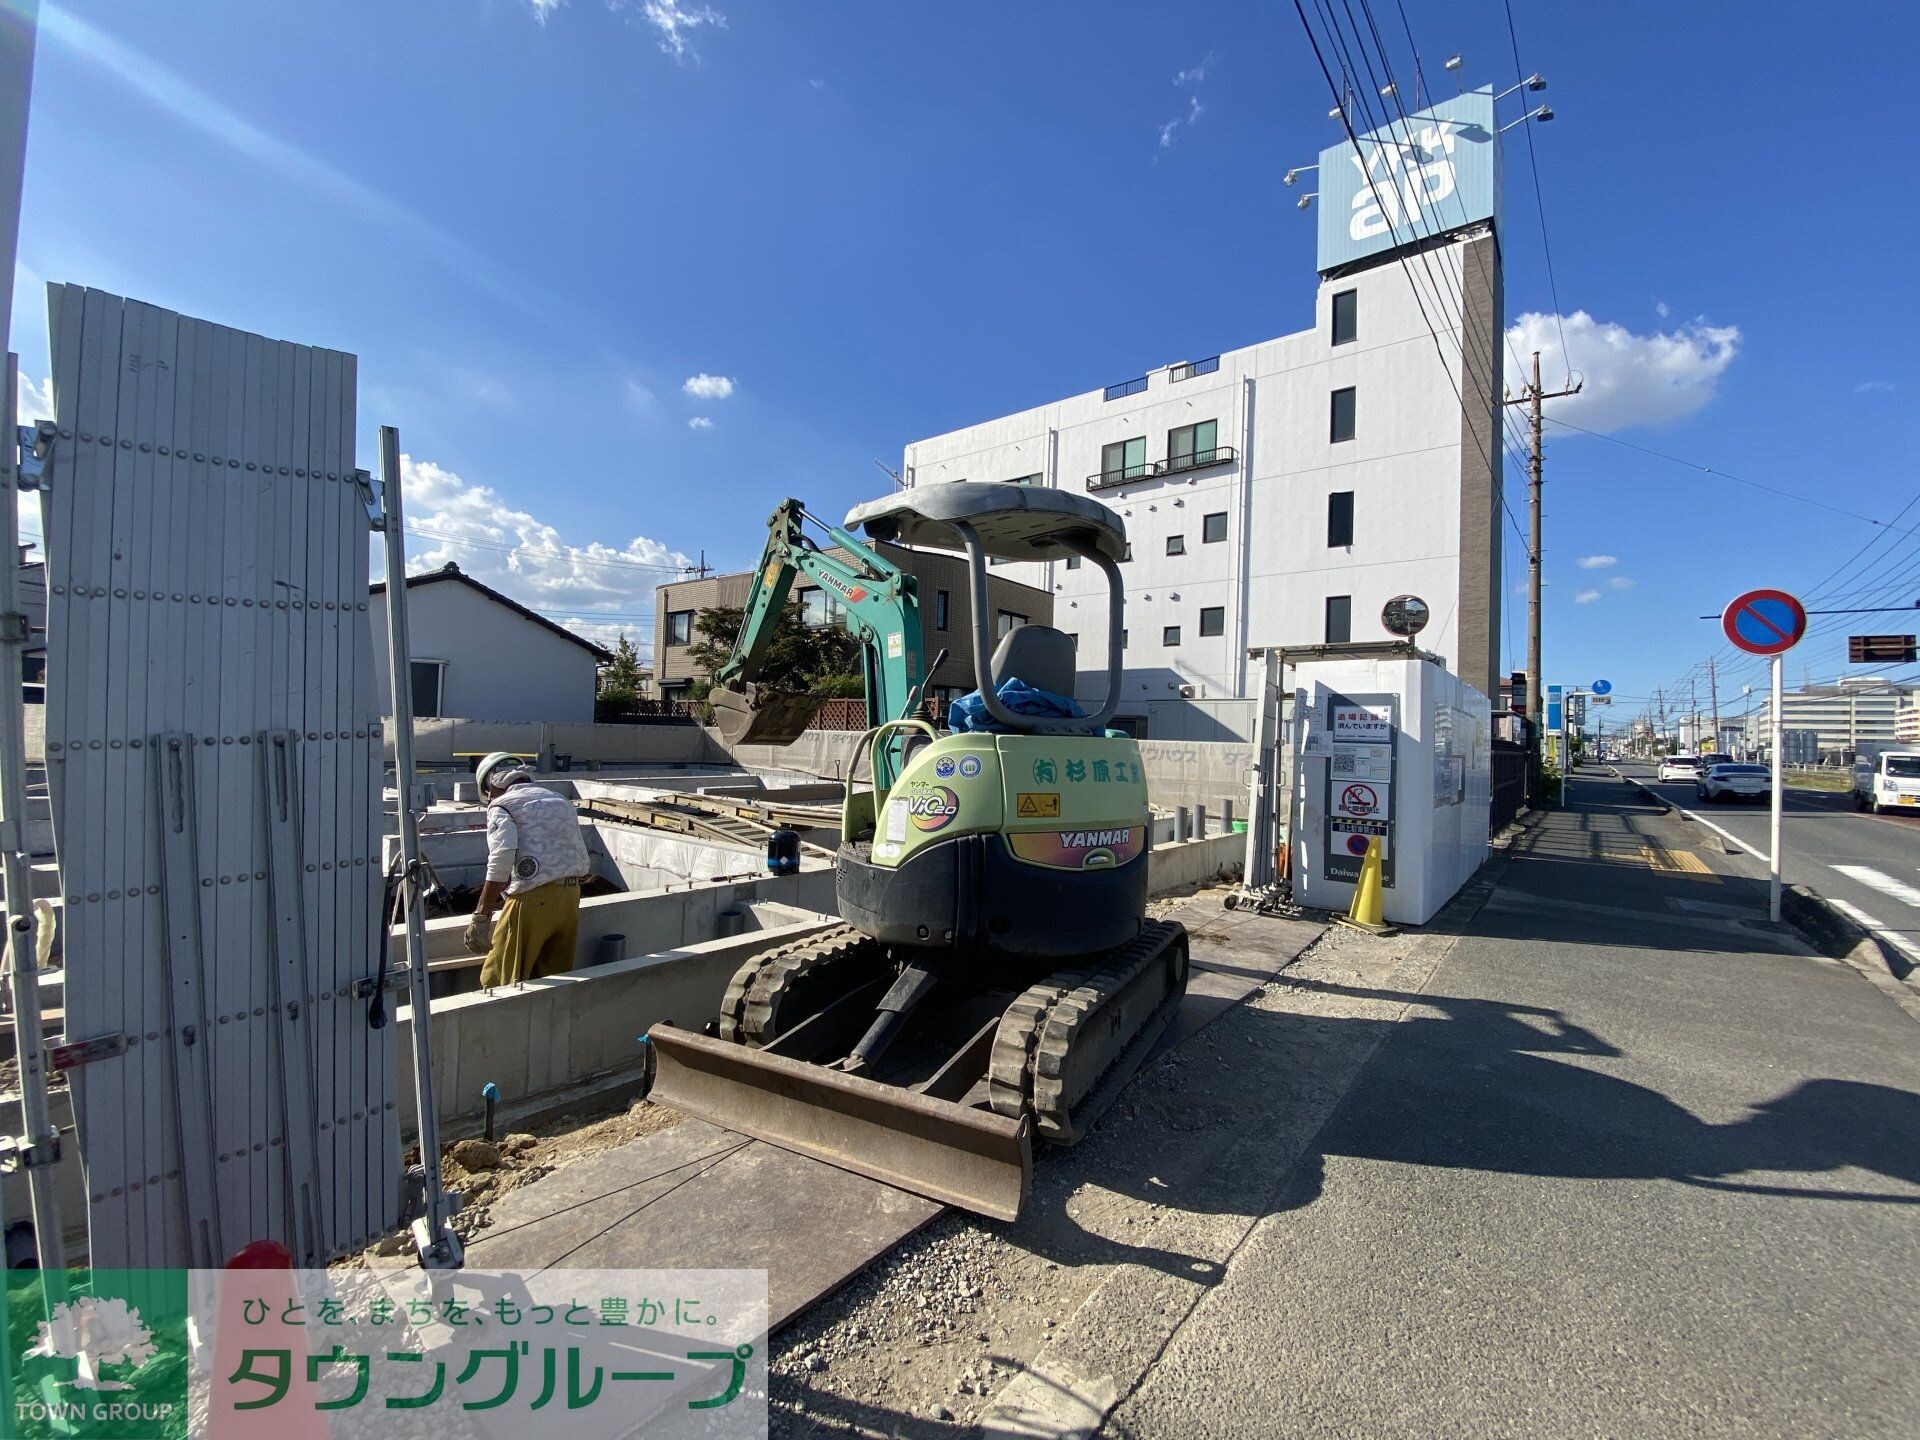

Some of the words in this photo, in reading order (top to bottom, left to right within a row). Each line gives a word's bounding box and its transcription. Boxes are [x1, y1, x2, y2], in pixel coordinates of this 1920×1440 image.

[817, 568, 855, 598] YANMAR
[1337, 722, 1388, 730] 済んでいますか
[1060, 829, 1130, 848] YANMAR
[1330, 867, 1360, 878] Daiwa
